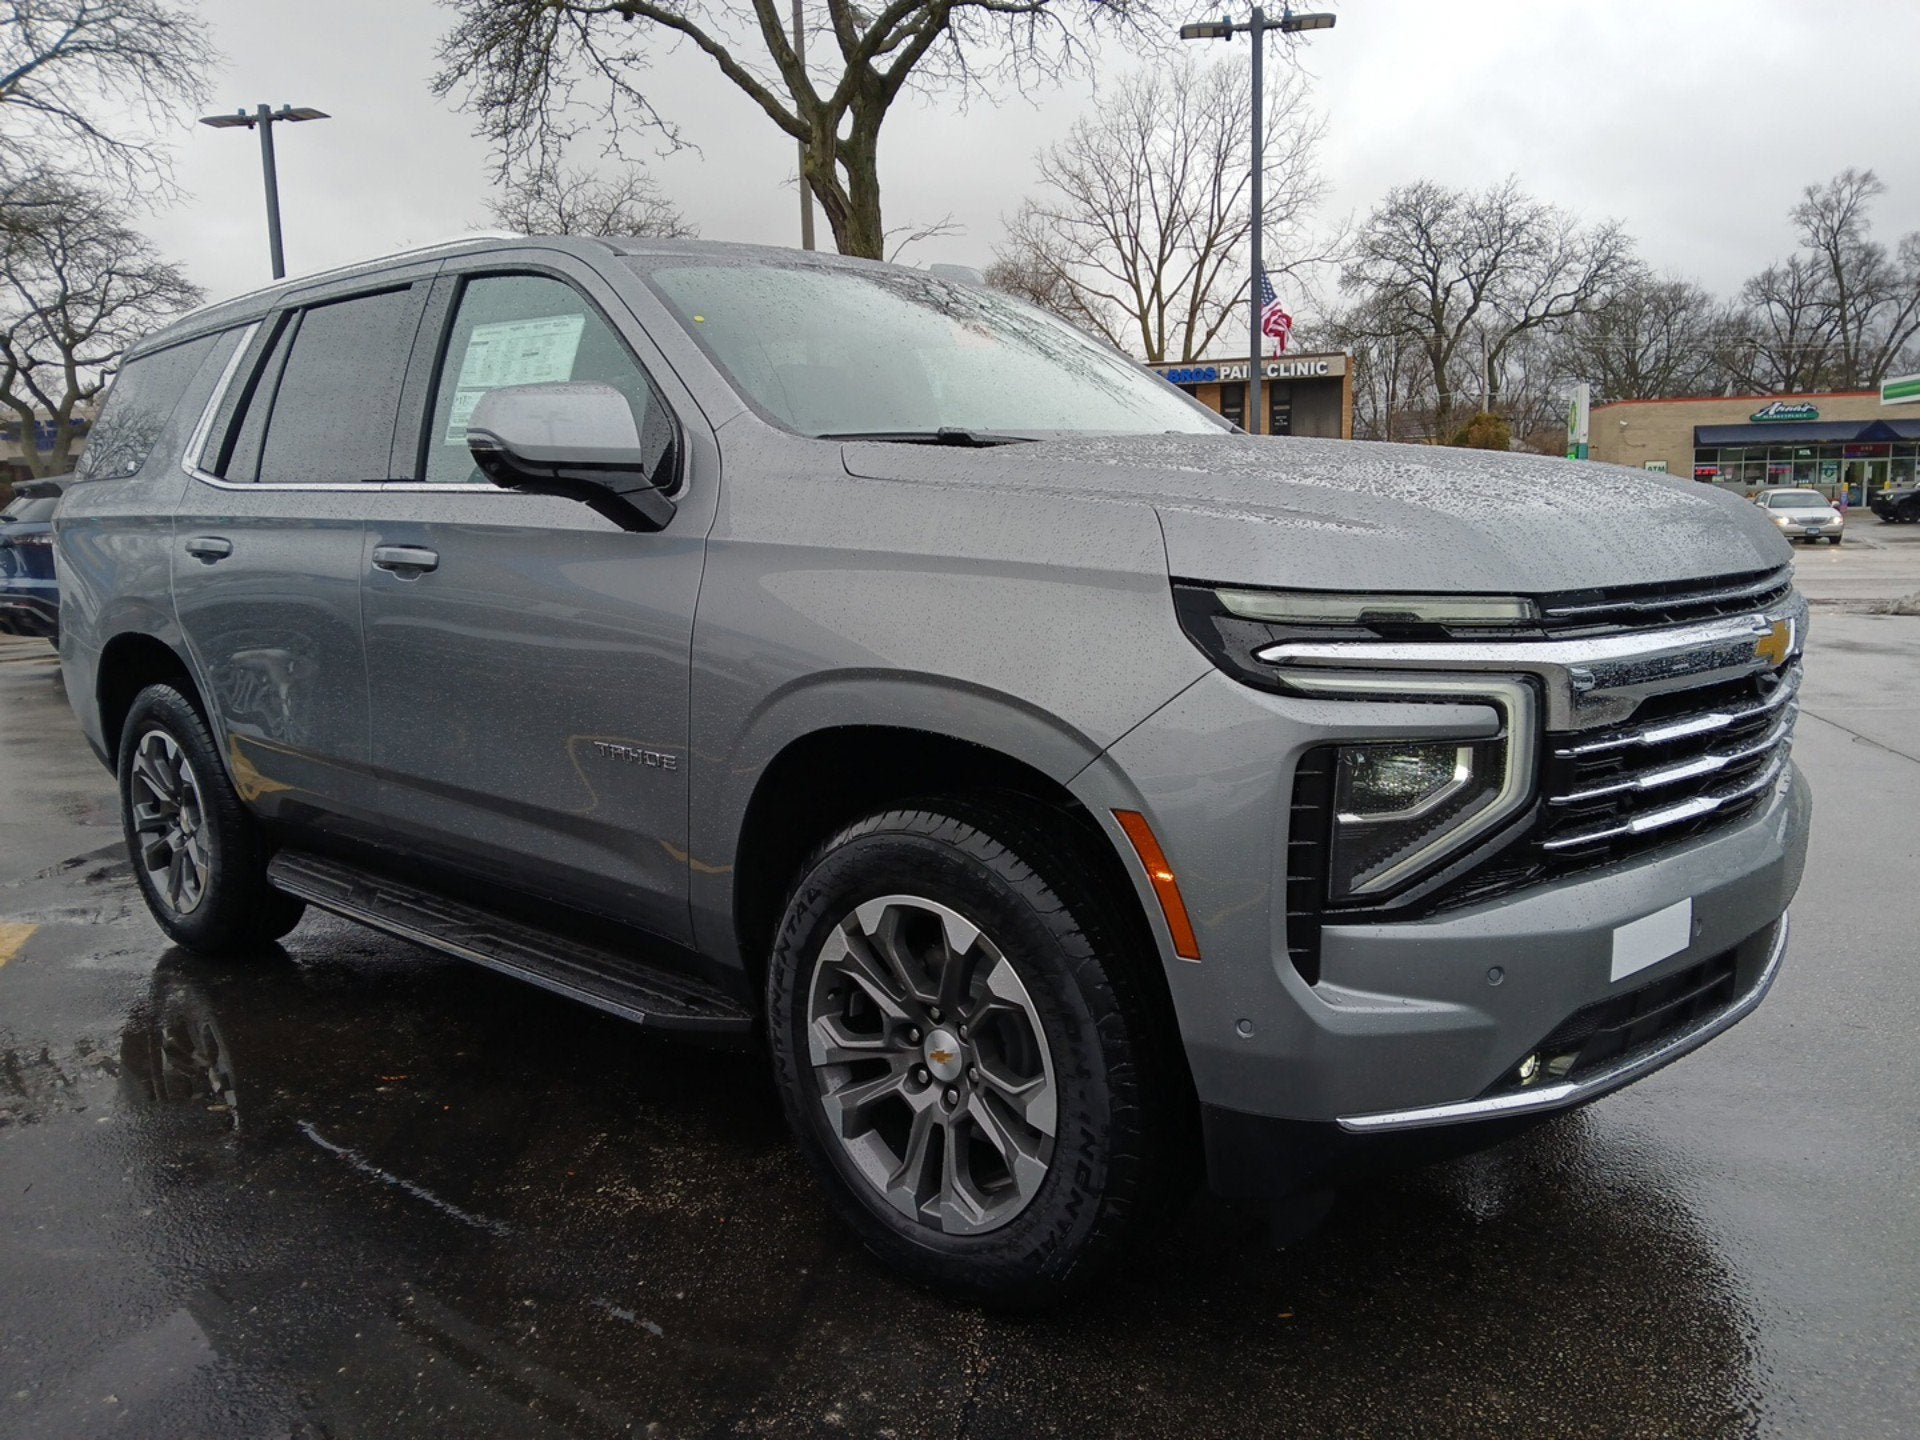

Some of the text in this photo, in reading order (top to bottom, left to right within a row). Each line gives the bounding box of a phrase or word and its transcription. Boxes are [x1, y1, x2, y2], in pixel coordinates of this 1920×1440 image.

[1167, 367, 1217, 383] BROS
[1220, 365, 1251, 380] PAI
[1267, 361, 1328, 377] CLINIC
[593, 740, 677, 770] TAHOE
